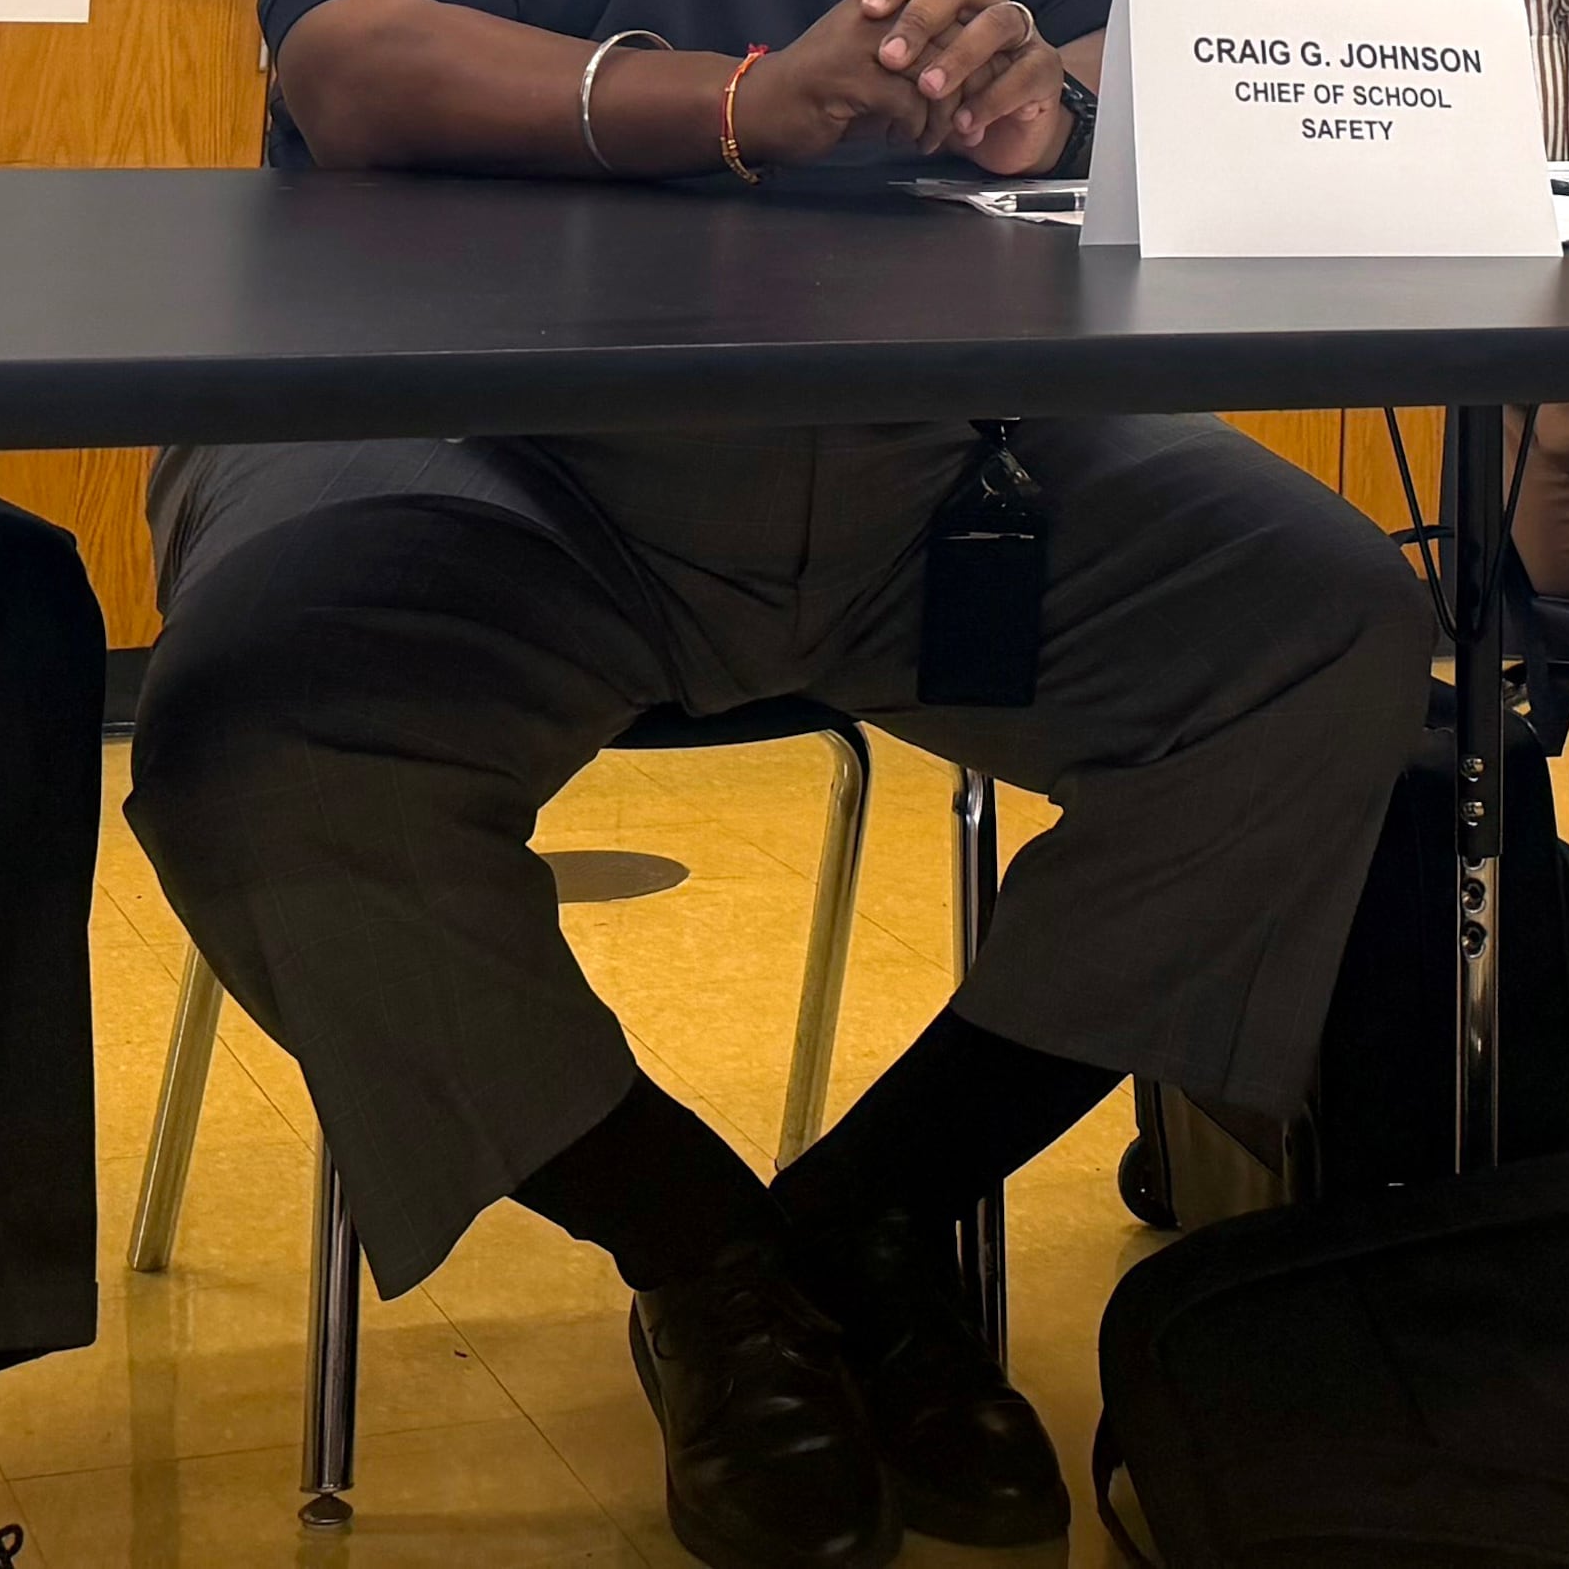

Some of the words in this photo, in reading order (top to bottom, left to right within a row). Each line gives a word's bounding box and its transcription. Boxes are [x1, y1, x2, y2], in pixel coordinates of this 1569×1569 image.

[1193, 37, 1291, 65] CRAIG
[1300, 41, 1331, 67] G.
[1339, 43, 1482, 73] JOHNSON
[1235, 81, 1306, 103] CHIEF
[1313, 84, 1346, 104] OF
[1353, 85, 1452, 109] SCHOOL
[1301, 118, 1394, 141] SAFETY
